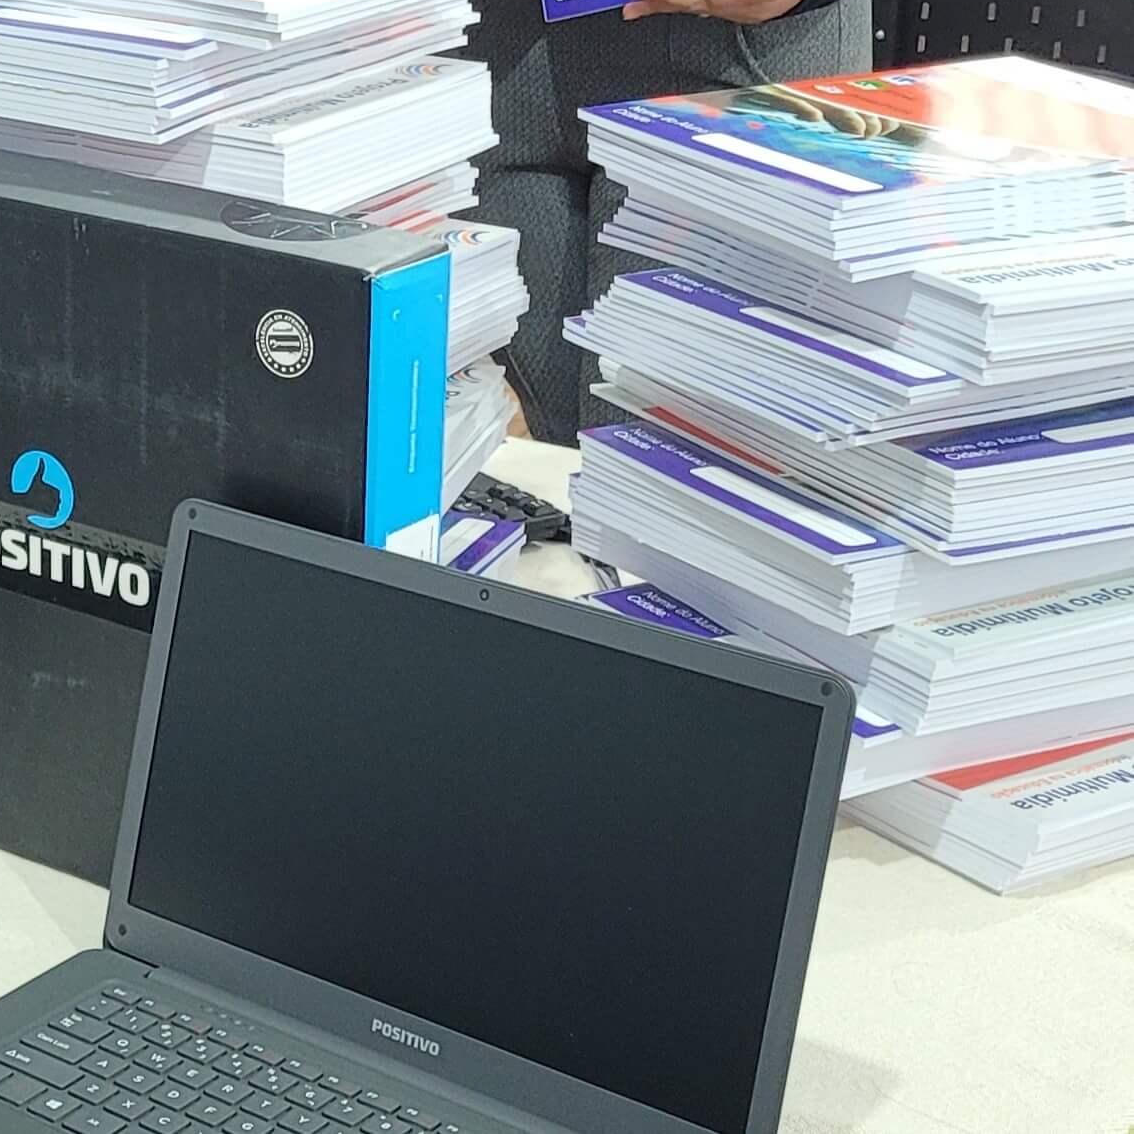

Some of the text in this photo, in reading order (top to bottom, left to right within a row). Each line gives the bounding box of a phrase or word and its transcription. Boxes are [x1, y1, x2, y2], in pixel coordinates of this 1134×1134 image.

[642, 591, 677, 610] Nome
[932, 602, 1074, 638] Multimídia
[1010, 768, 1134, 810] Multimídia
[371, 1017, 440, 1056] POSITIVO
